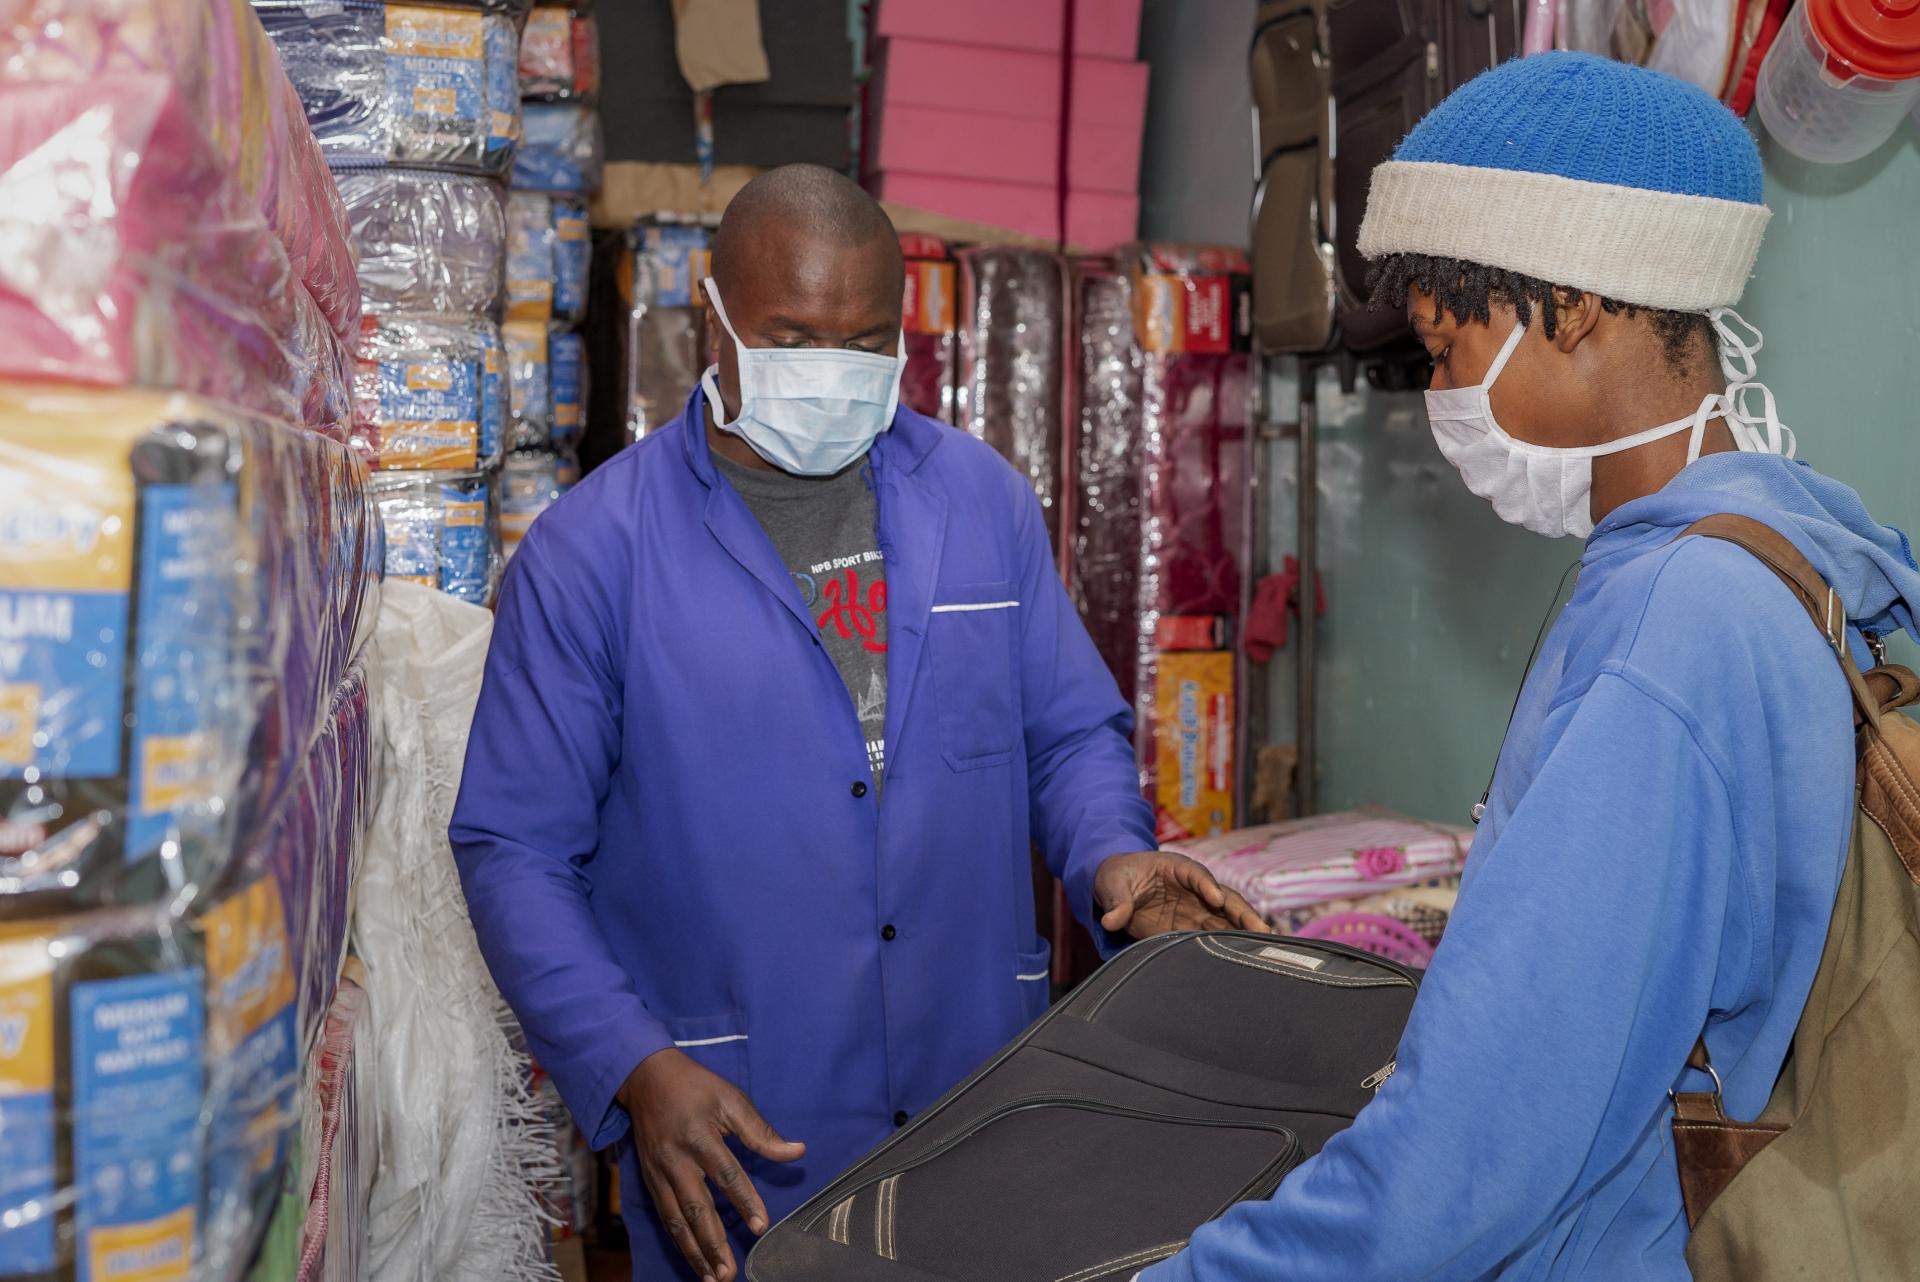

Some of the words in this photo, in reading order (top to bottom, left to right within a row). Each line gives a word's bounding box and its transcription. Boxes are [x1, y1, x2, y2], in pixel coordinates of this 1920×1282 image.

[811, 561, 832, 575] NPB
[832, 554, 861, 570] SPORT
[1179, 678, 1199, 729] glory
[1179, 731, 1198, 808] morning
[94, 993, 189, 1030] MEDIUM
[96, 1037, 189, 1075] MATTRESS
